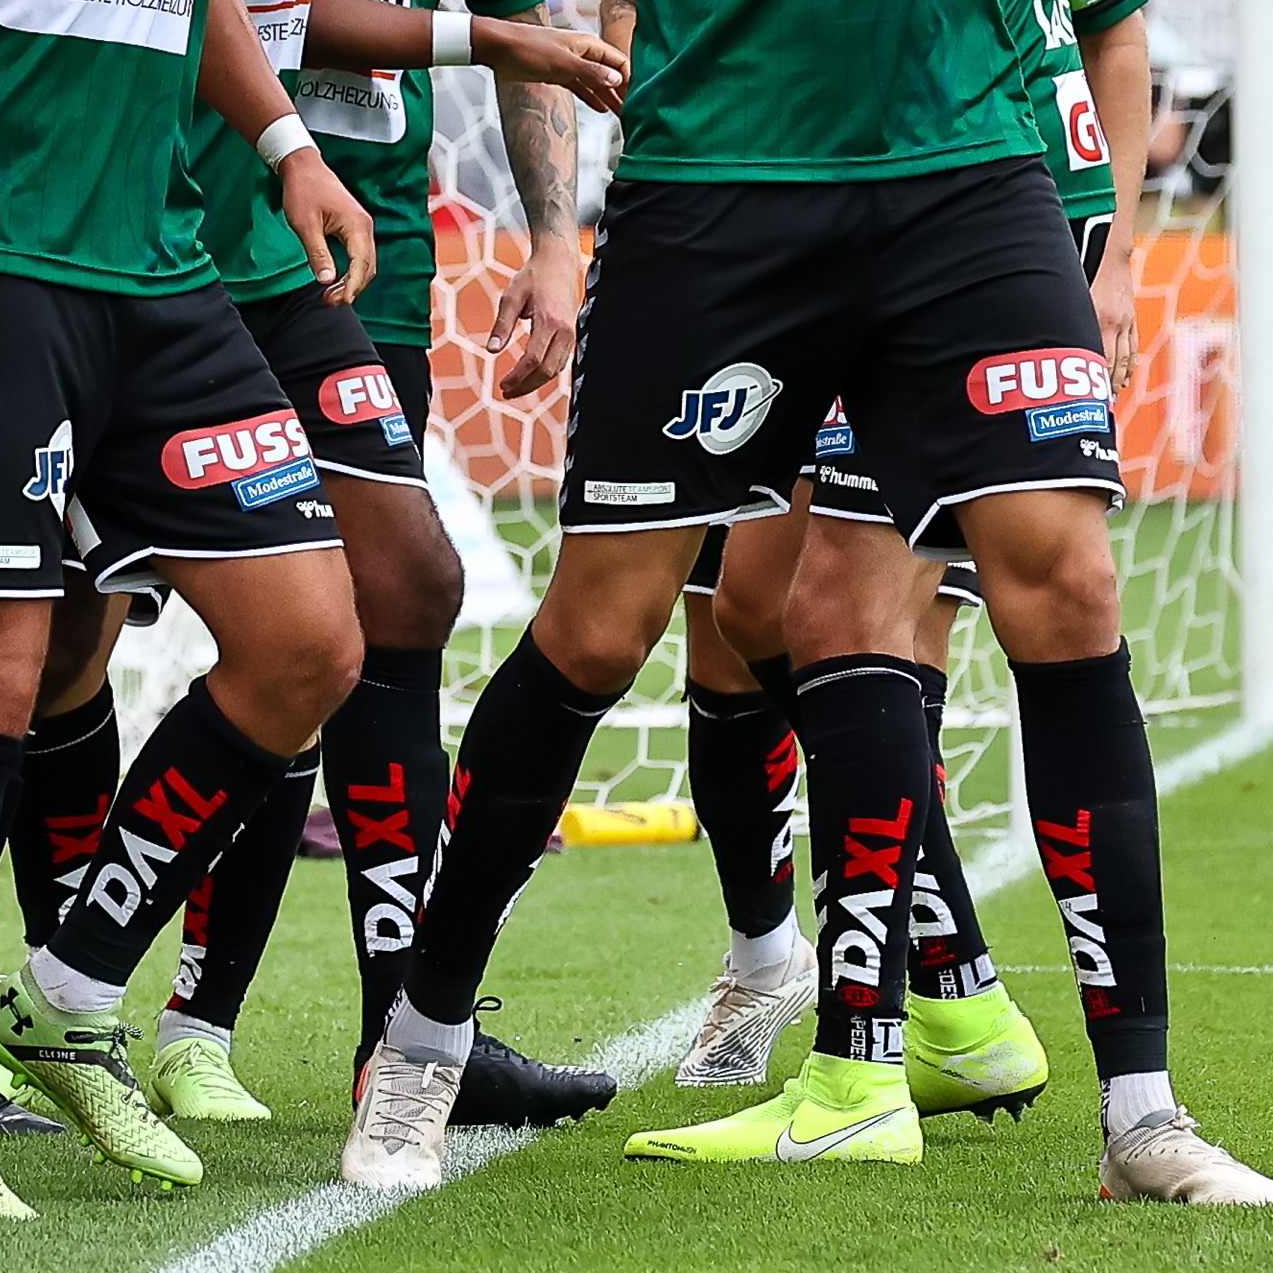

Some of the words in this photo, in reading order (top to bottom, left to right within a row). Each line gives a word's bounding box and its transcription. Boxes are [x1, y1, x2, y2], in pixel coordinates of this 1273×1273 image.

[86, 765, 229, 928] DAXL
[346, 762, 419, 958] DAXL
[831, 797, 914, 991] DAXL
[1035, 808, 1118, 993] DAXL
